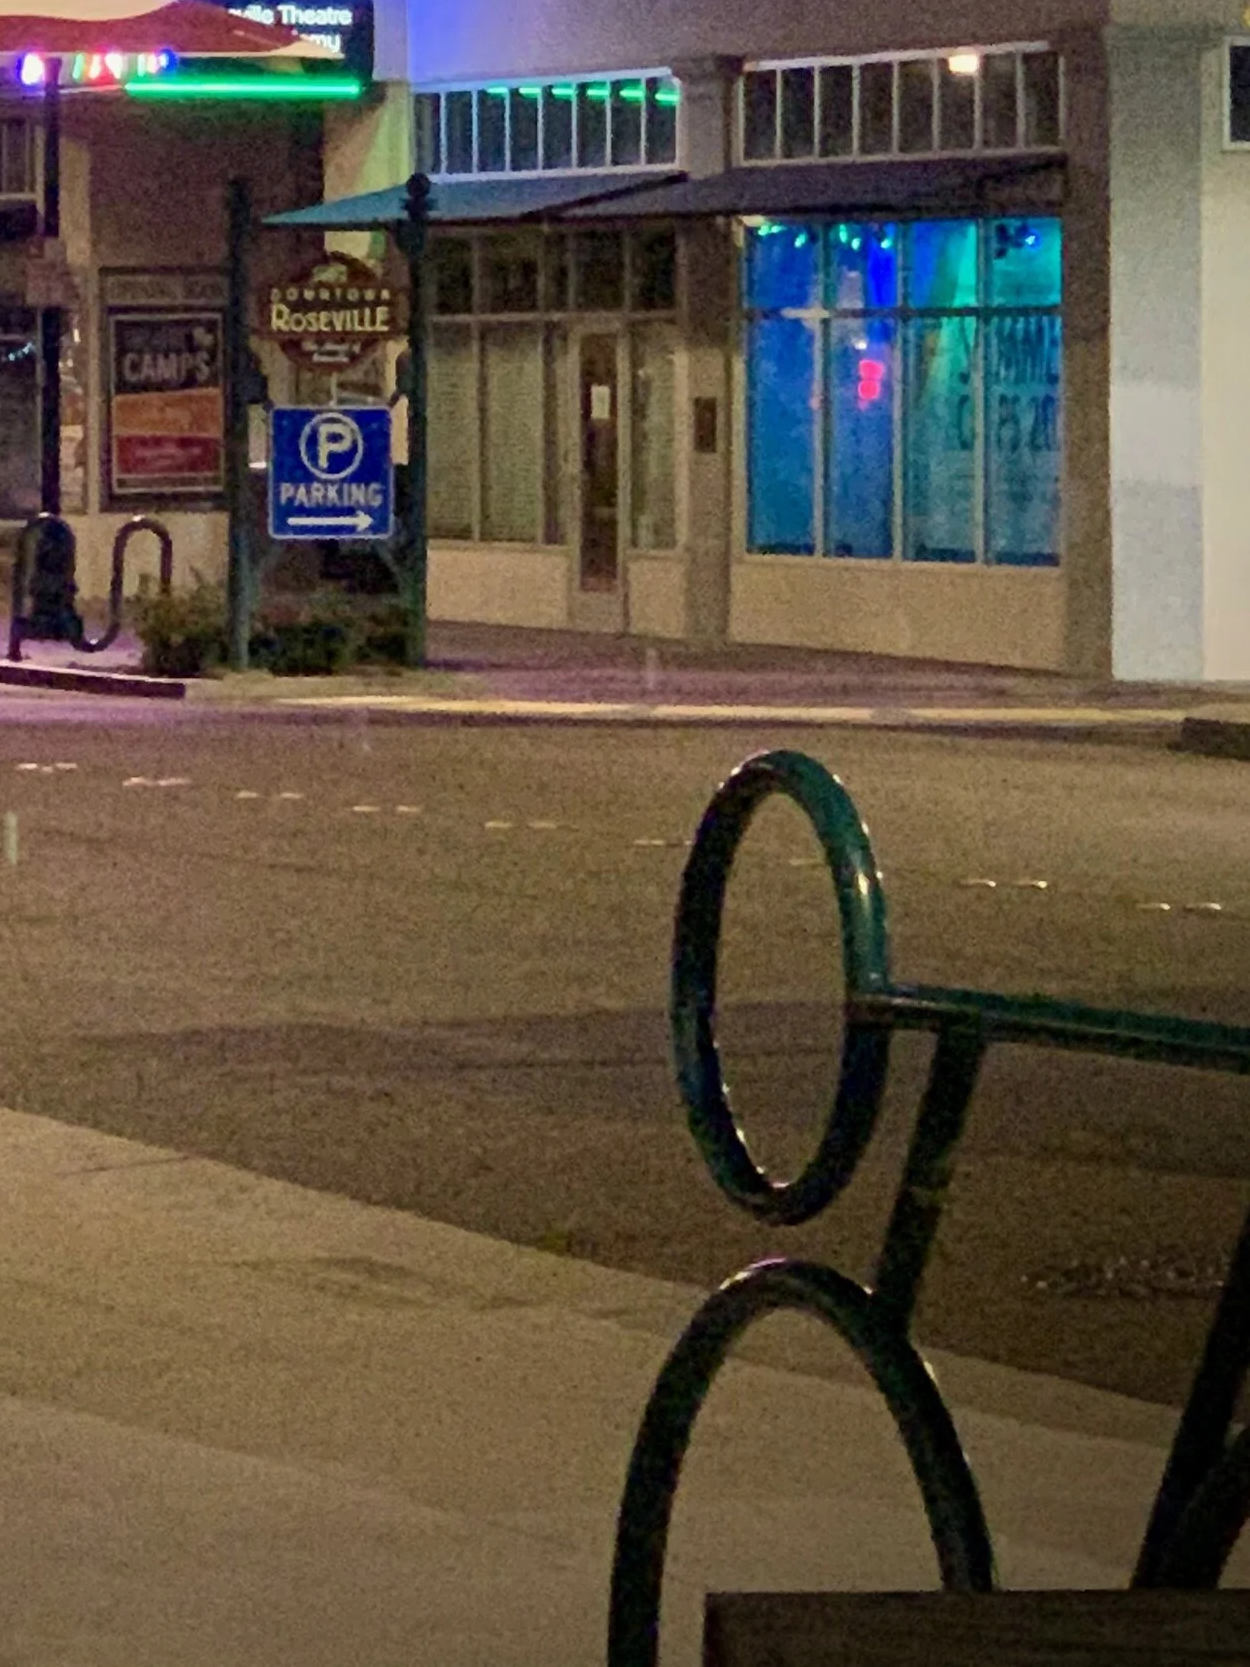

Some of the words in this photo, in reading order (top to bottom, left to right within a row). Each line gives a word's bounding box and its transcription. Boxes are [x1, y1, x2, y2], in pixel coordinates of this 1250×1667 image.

[276, 3, 353, 26] Theatre
[123, 352, 210, 382] CAMPS
[279, 481, 383, 508] PARKING
